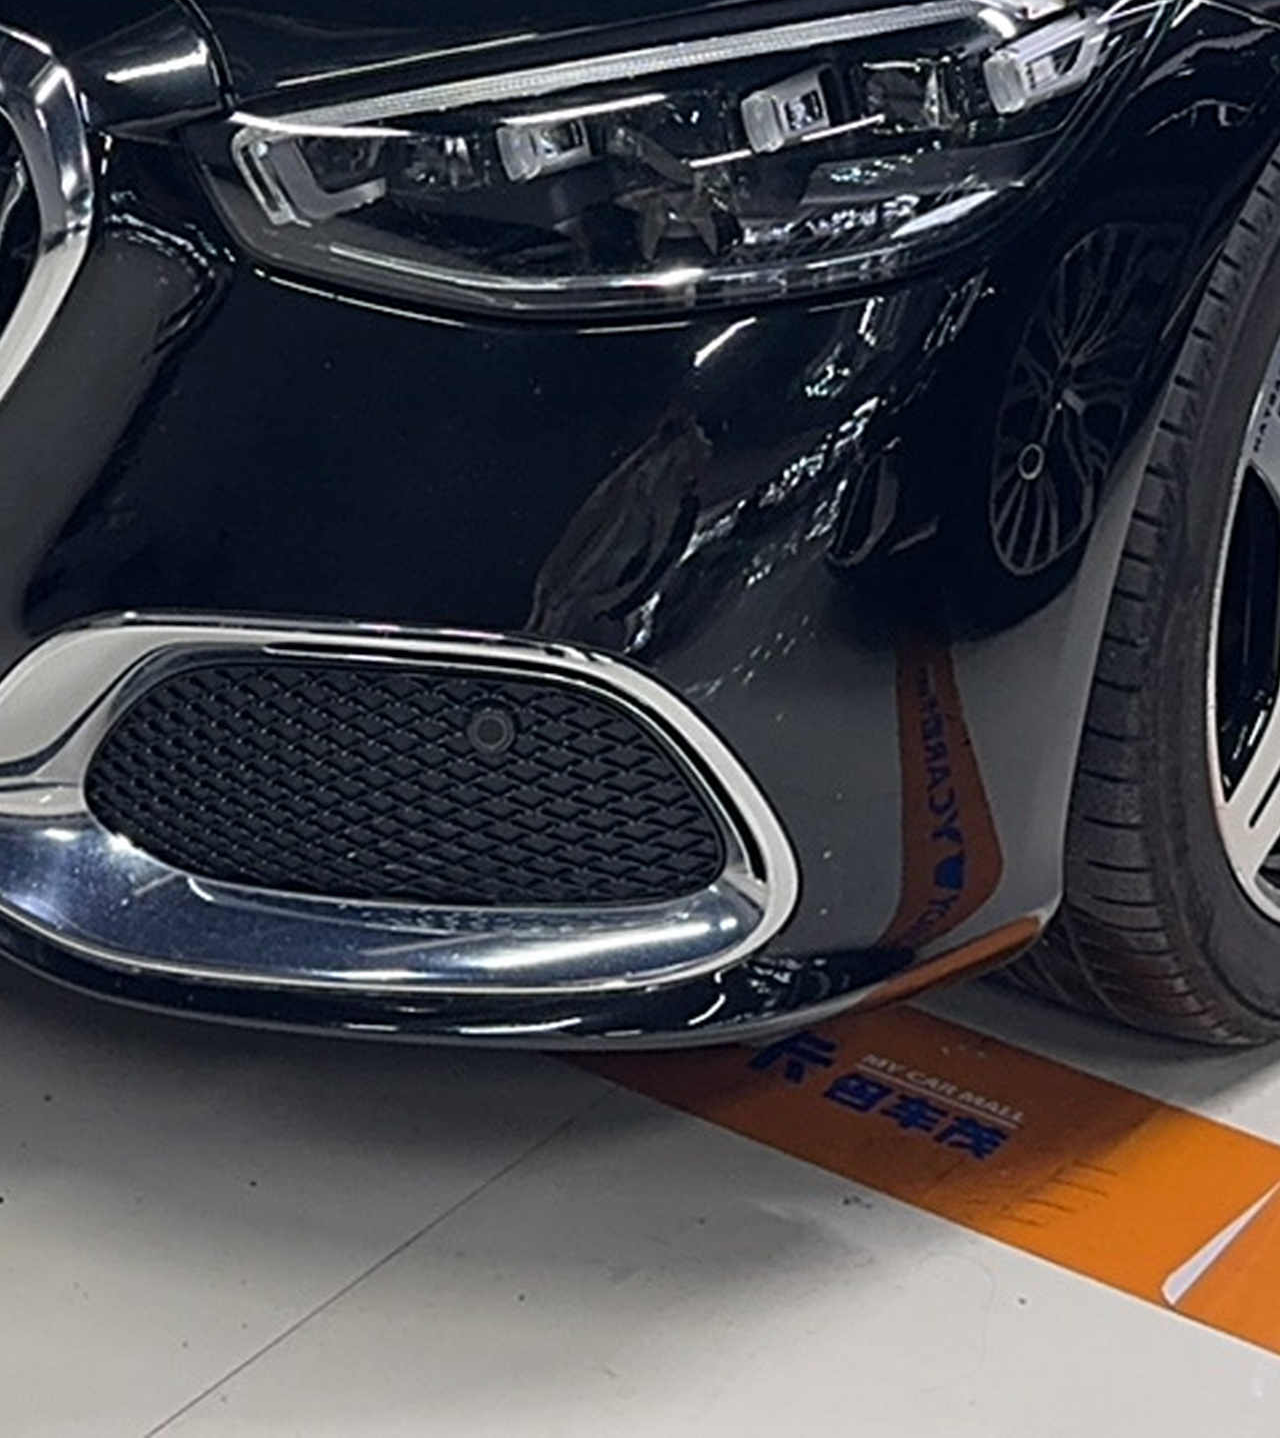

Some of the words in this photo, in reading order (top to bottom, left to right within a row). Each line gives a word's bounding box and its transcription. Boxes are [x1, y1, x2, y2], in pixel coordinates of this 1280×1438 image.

[861, 1053, 904, 1076] MY
[907, 1072, 955, 1097] CAR
[957, 1088, 1024, 1123] MALL
